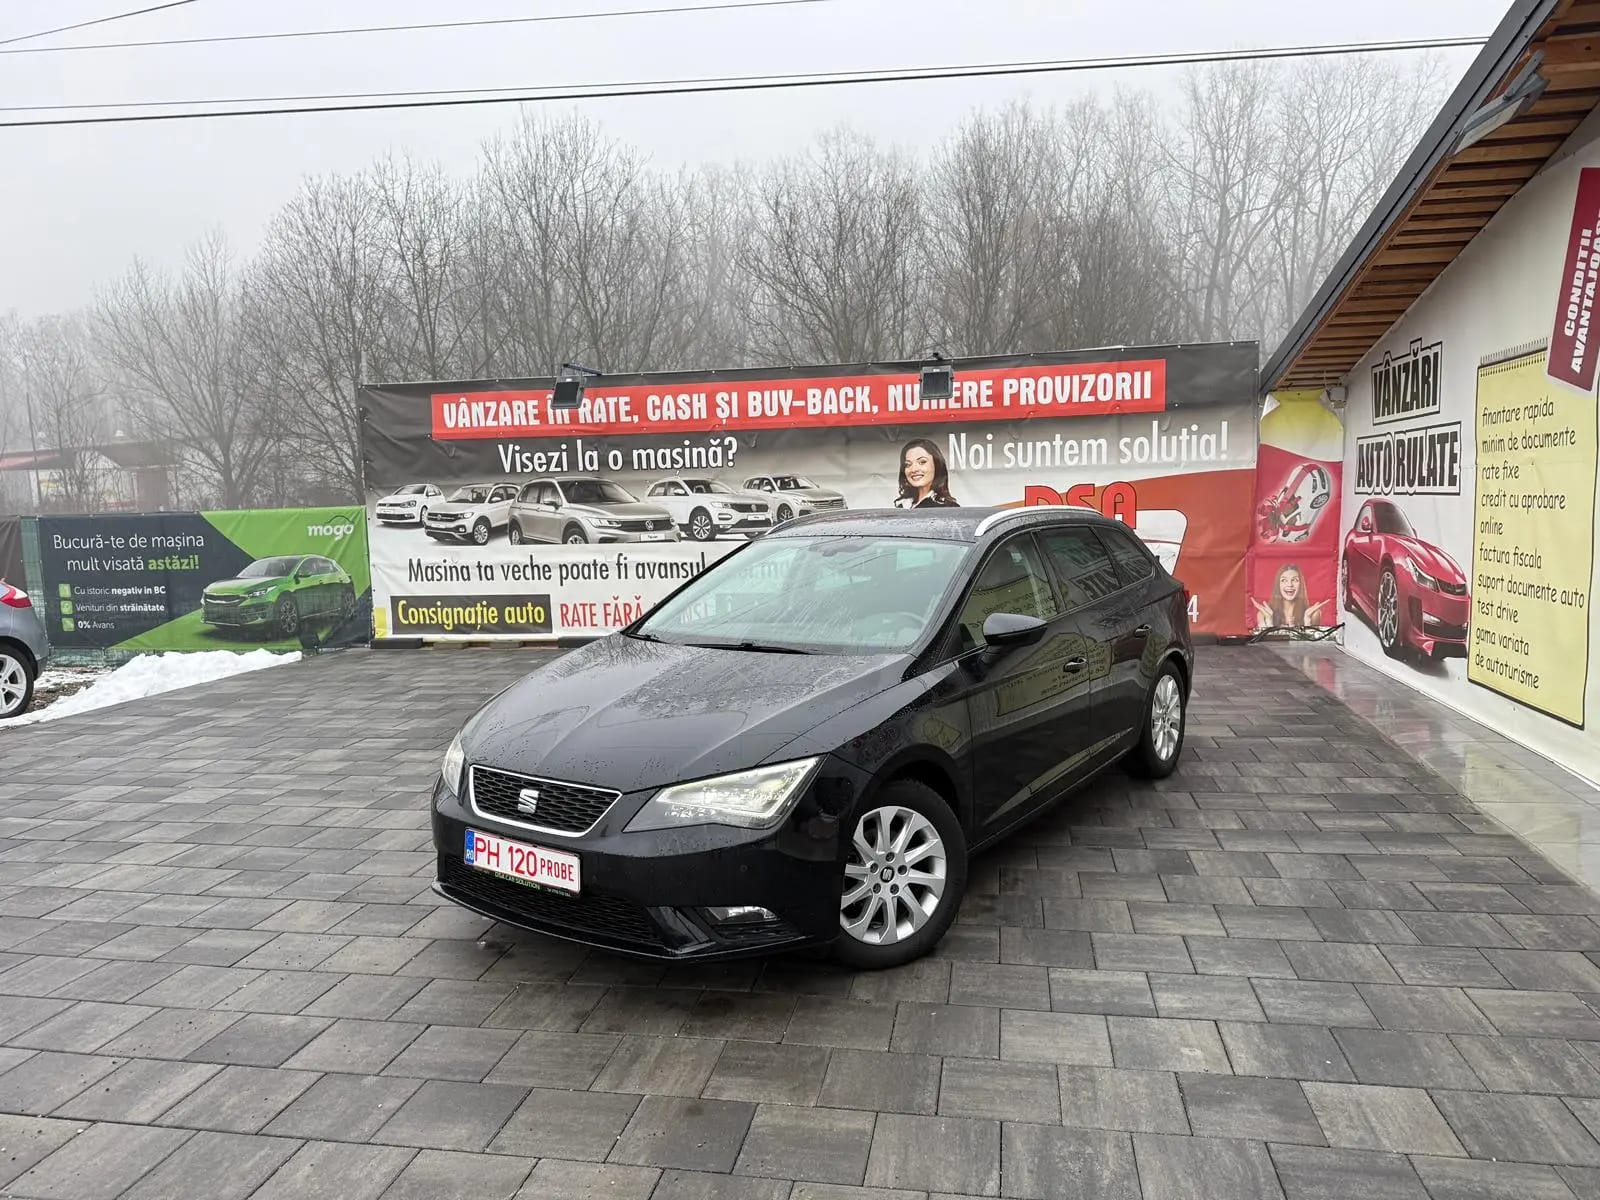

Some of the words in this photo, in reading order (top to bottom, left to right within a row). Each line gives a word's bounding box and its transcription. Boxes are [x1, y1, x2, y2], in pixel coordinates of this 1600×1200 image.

[1564, 228, 1592, 337] CONDITII
[1571, 209, 1600, 373] AVANTAJOA
[1374, 347, 1439, 418] VÂNZĂRI
[443, 397, 540, 428] VÂNZARE
[578, 396, 639, 424] RATE,
[646, 392, 707, 421] CASH
[716, 391, 738, 425] ȘI
[748, 386, 879, 417] BUY-BACK,
[1003, 370, 1151, 407] PROVIZORII
[1482, 405, 1520, 427] finantare
[1523, 395, 1554, 425] rapida
[948, 432, 993, 470] Noi
[1003, 433, 1107, 467] suntem
[1482, 433, 1505, 453] minim
[1508, 431, 1519, 451] de
[1521, 426, 1576, 449] documente
[498, 443, 568, 473] Visezi
[576, 439, 599, 472] la
[607, 449, 623, 471] o
[632, 436, 738, 477] mașină?
[1357, 440, 1393, 488] AUTO
[1395, 431, 1458, 488] RULATE
[1482, 463, 1500, 480] rate
[1502, 459, 1519, 480] fixe
[1481, 488, 1506, 507] credit
[1509, 493, 1519, 508] cu
[1521, 488, 1566, 514] aprobare
[307, 524, 354, 541] mogo
[1480, 515, 1503, 535] online
[53, 534, 125, 549] Bucură-te
[128, 533, 148, 548] de
[151, 532, 205, 551] mașina
[1479, 542, 1510, 564] factura
[1513, 545, 1542, 569] fiscala
[67, 557, 100, 571] mult
[102, 556, 145, 571] visată
[148, 554, 200, 570] astăzi!
[476, 560, 495, 581] ta
[501, 554, 552, 581] veche
[559, 559, 609, 587] poate
[616, 552, 628, 580] fi
[74, 586, 87, 595] Cu
[87, 586, 110, 595] istoric
[111, 586, 143, 597] negativ
[153, 585, 166, 594] BC
[1477, 573, 1504, 594] suport
[1507, 574, 1558, 603] documente
[1560, 587, 1585, 609] auto
[75, 603, 105, 612] Venituri
[106, 603, 119, 612] din
[120, 603, 165, 612] străinătate
[398, 599, 499, 631] Consignație
[504, 601, 545, 624] auto
[560, 602, 598, 627] RATE
[603, 595, 643, 627] FĂRĂ
[1477, 597, 1494, 616] test
[1496, 599, 1519, 623] drive
[77, 620, 91, 629] 0%
[92, 621, 115, 629] Avans
[1476, 626, 1496, 645] gama
[1498, 633, 1530, 656] variata
[1475, 649, 1484, 668] de
[1485, 657, 1540, 689] autoturisme
[475, 837, 500, 867] PH
[508, 845, 538, 877] 120
[540, 857, 575, 882] PROBE
